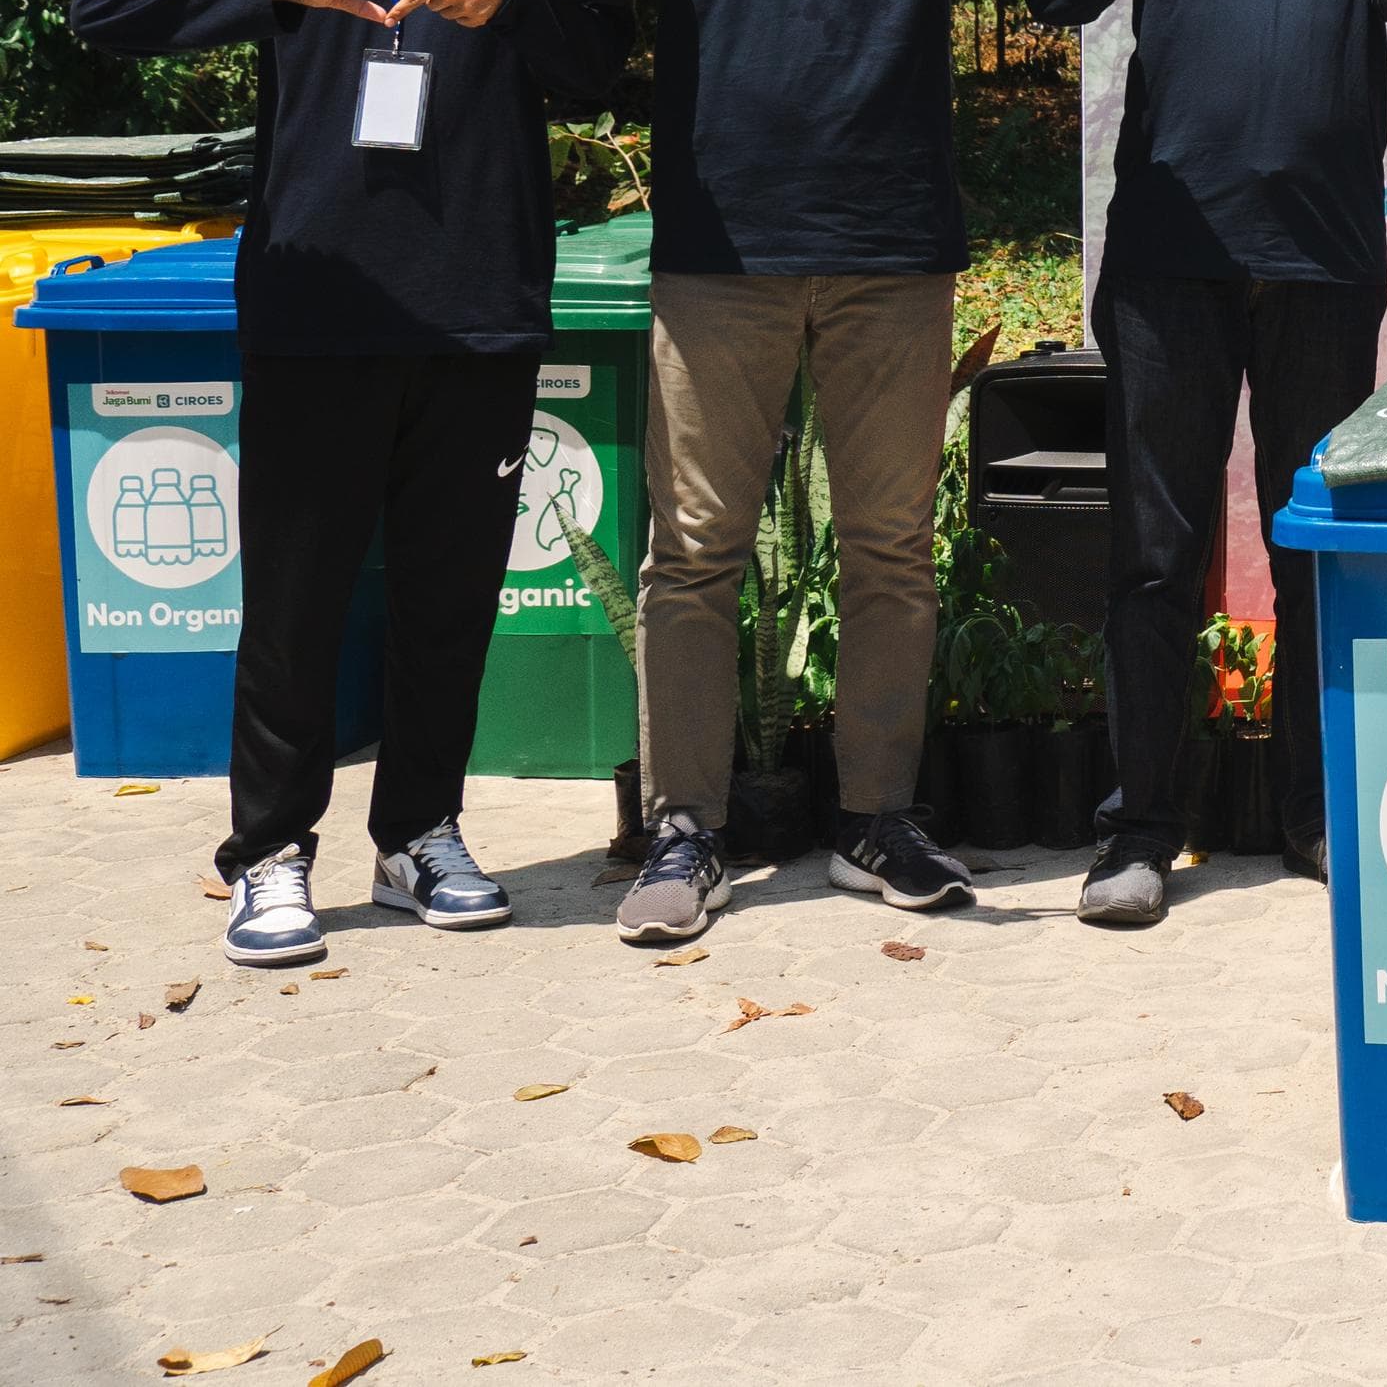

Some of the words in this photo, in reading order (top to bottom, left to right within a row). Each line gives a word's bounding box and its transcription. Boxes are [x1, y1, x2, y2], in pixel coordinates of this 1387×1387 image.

[102, 396, 126, 407] Jaga
[127, 396, 151, 406] Bumi
[175, 395, 224, 406] CIROES
[499, 578, 592, 615] ganic
[87, 603, 143, 626] Non
[149, 602, 240, 632] Organ
